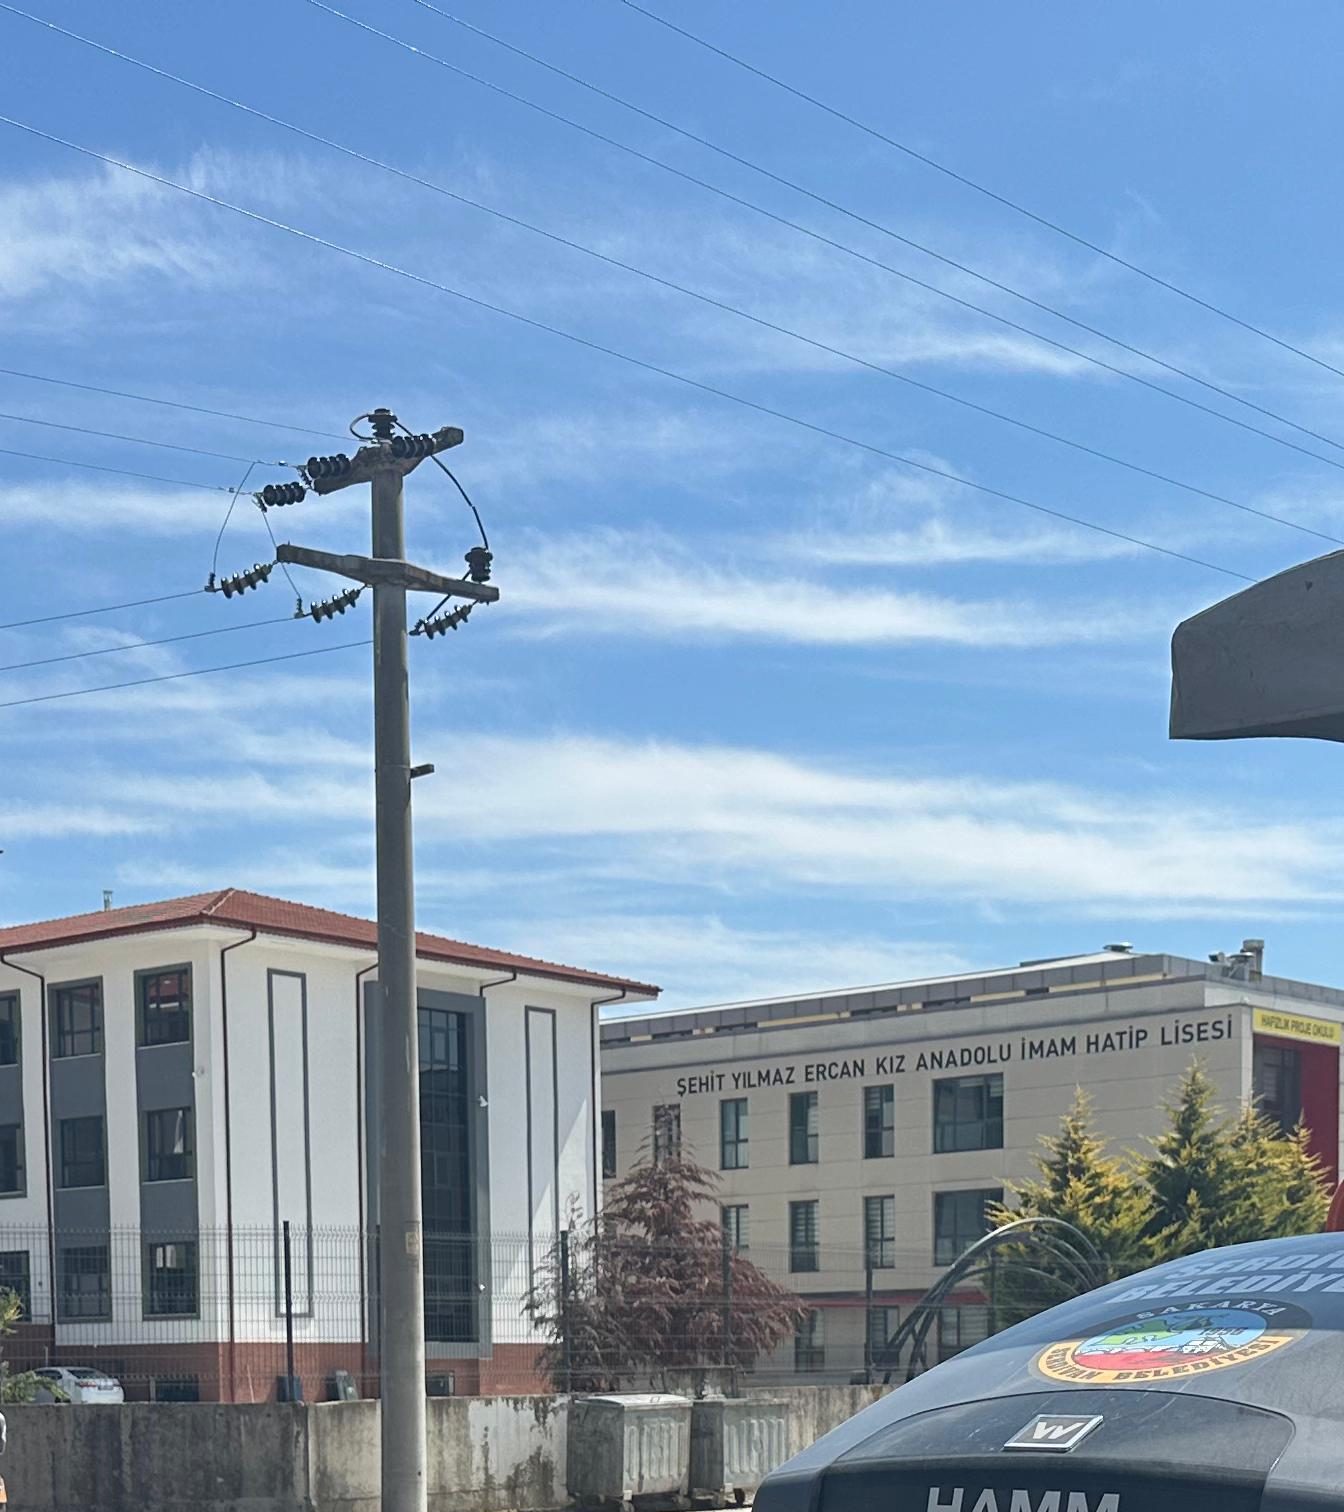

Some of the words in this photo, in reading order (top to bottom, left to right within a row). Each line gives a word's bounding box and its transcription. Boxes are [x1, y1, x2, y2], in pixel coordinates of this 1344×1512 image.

[677, 1070, 725, 1097] ŞEHİT
[732, 1066, 795, 1089] YILMAZ
[805, 1059, 865, 1082] ERCAN
[876, 1055, 905, 1075] KIZ
[916, 1043, 1011, 1071] ANADOLU
[1021, 1037, 1076, 1060] İMAM
[1086, 1025, 1148, 1053] HATİP
[1161, 1014, 1233, 1046] LİSESİ
[1136, 1300, 1287, 1319] SAKARYA
